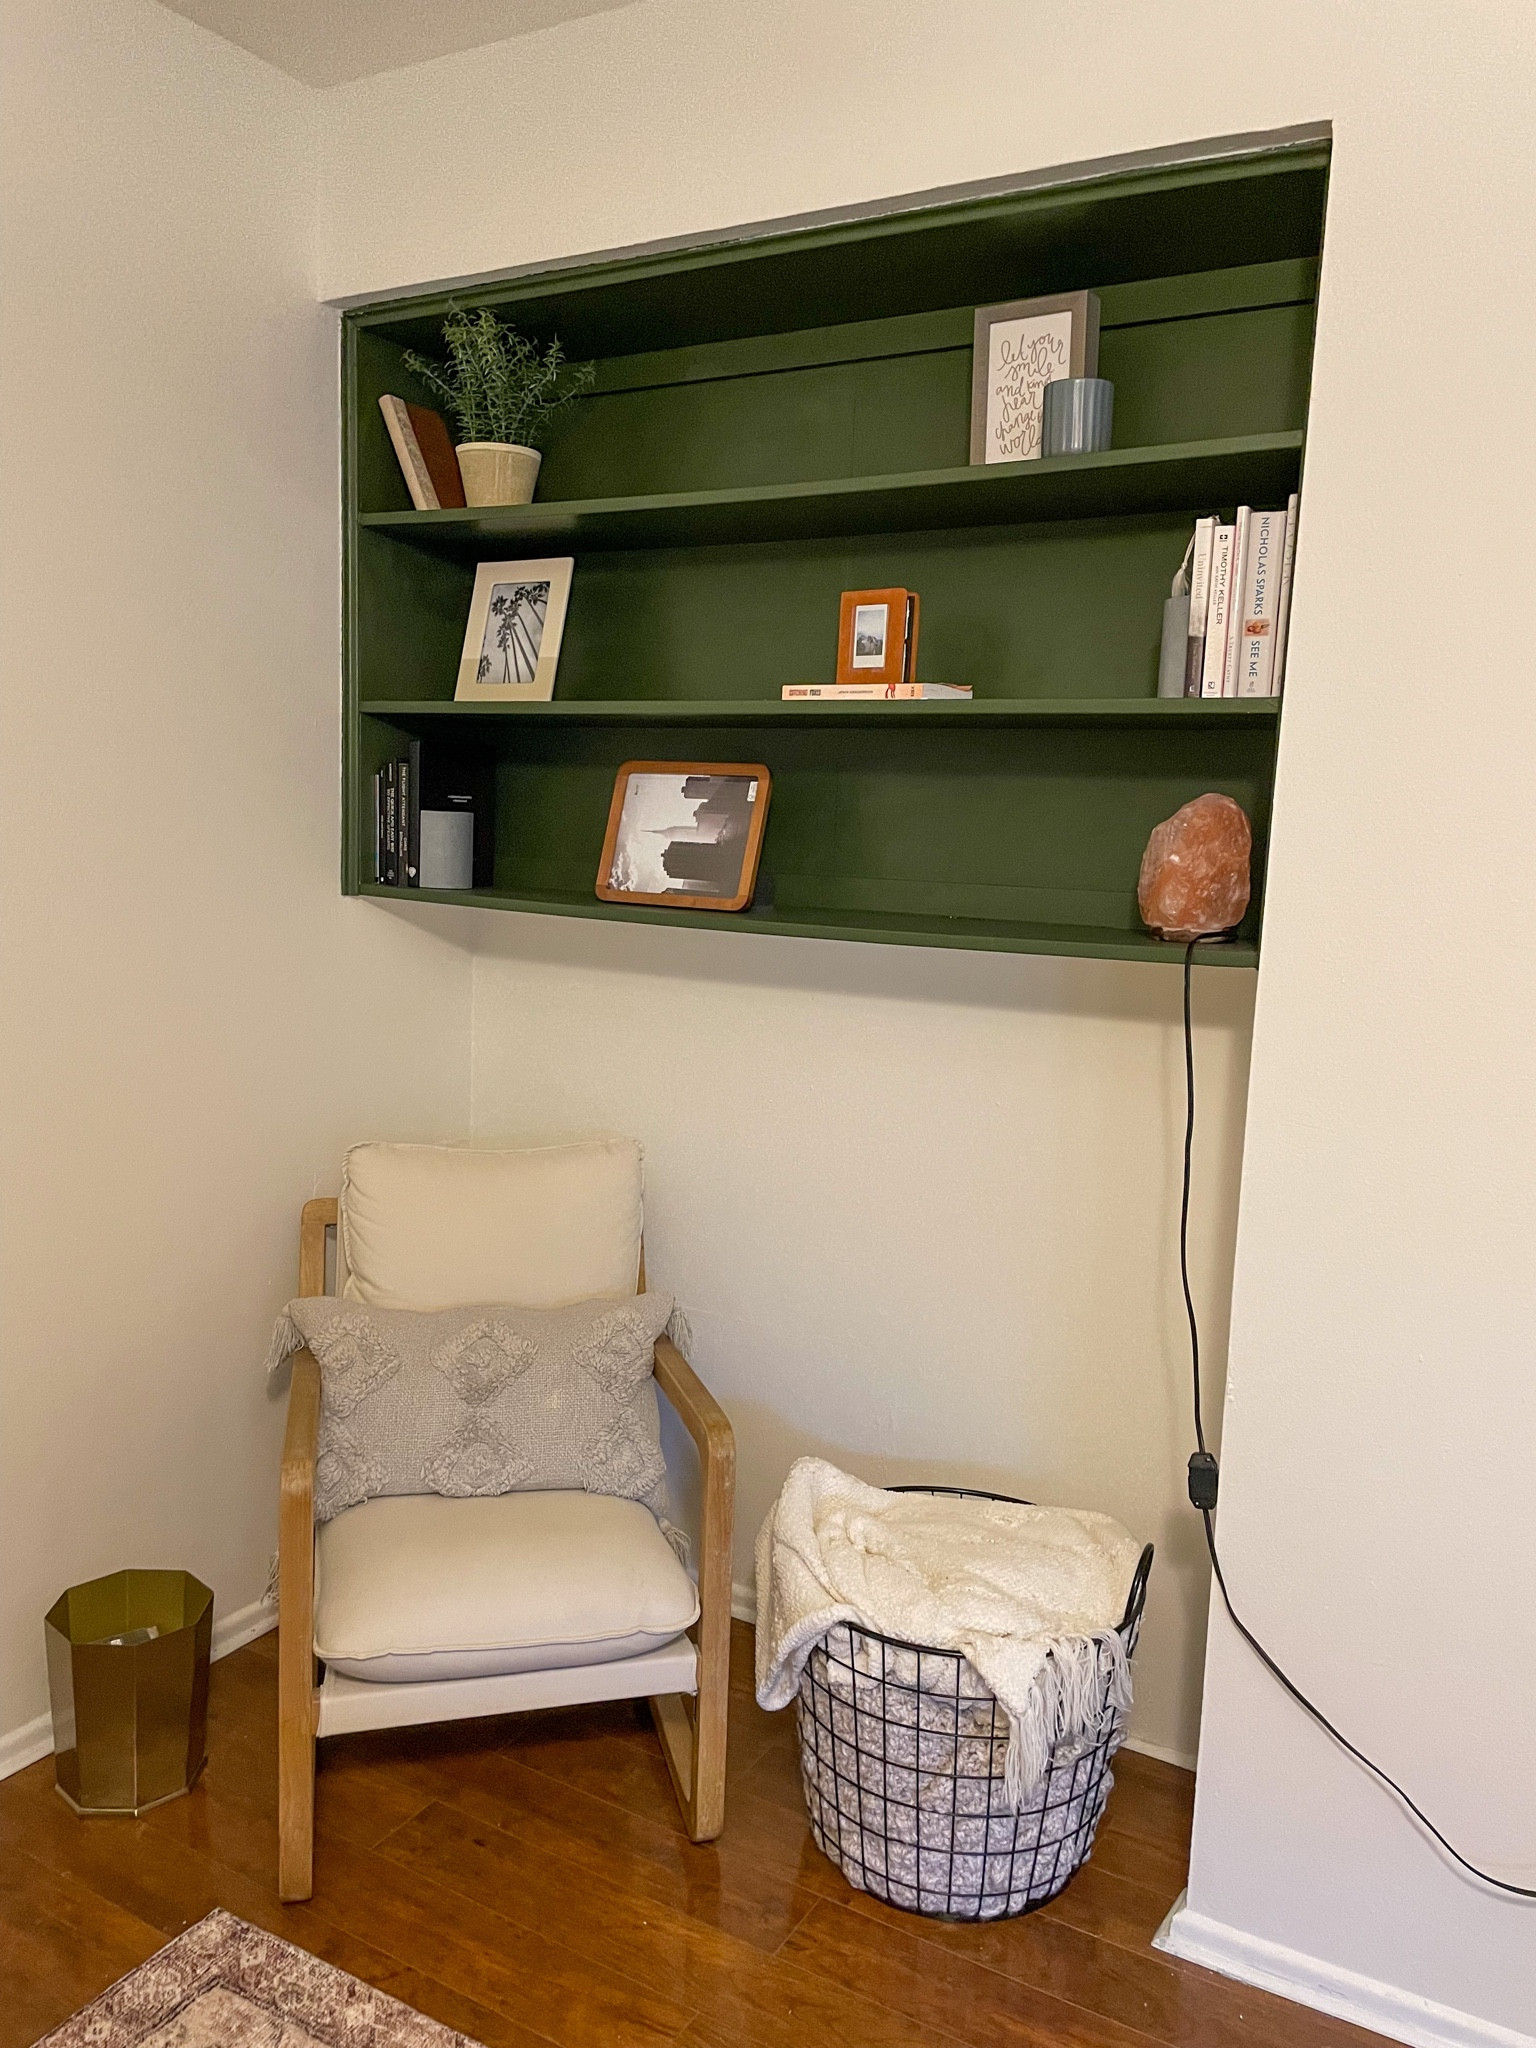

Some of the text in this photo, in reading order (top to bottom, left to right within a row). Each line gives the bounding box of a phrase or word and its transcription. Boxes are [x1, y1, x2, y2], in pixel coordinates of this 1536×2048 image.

[997, 333, 1066, 371] let your
[1004, 347, 1054, 381] smile
[996, 377, 1026, 397] and
[1002, 391, 1042, 422] hear
[995, 409, 1036, 441] change
[1195, 553, 1206, 600] Uninvited
[1254, 517, 1270, 615] NICHOLAS SPARKS
[1216, 546, 1228, 625] TIMOTHY KELLER
[1250, 640, 1260, 659] SEE
[1249, 661, 1258, 678] ME
